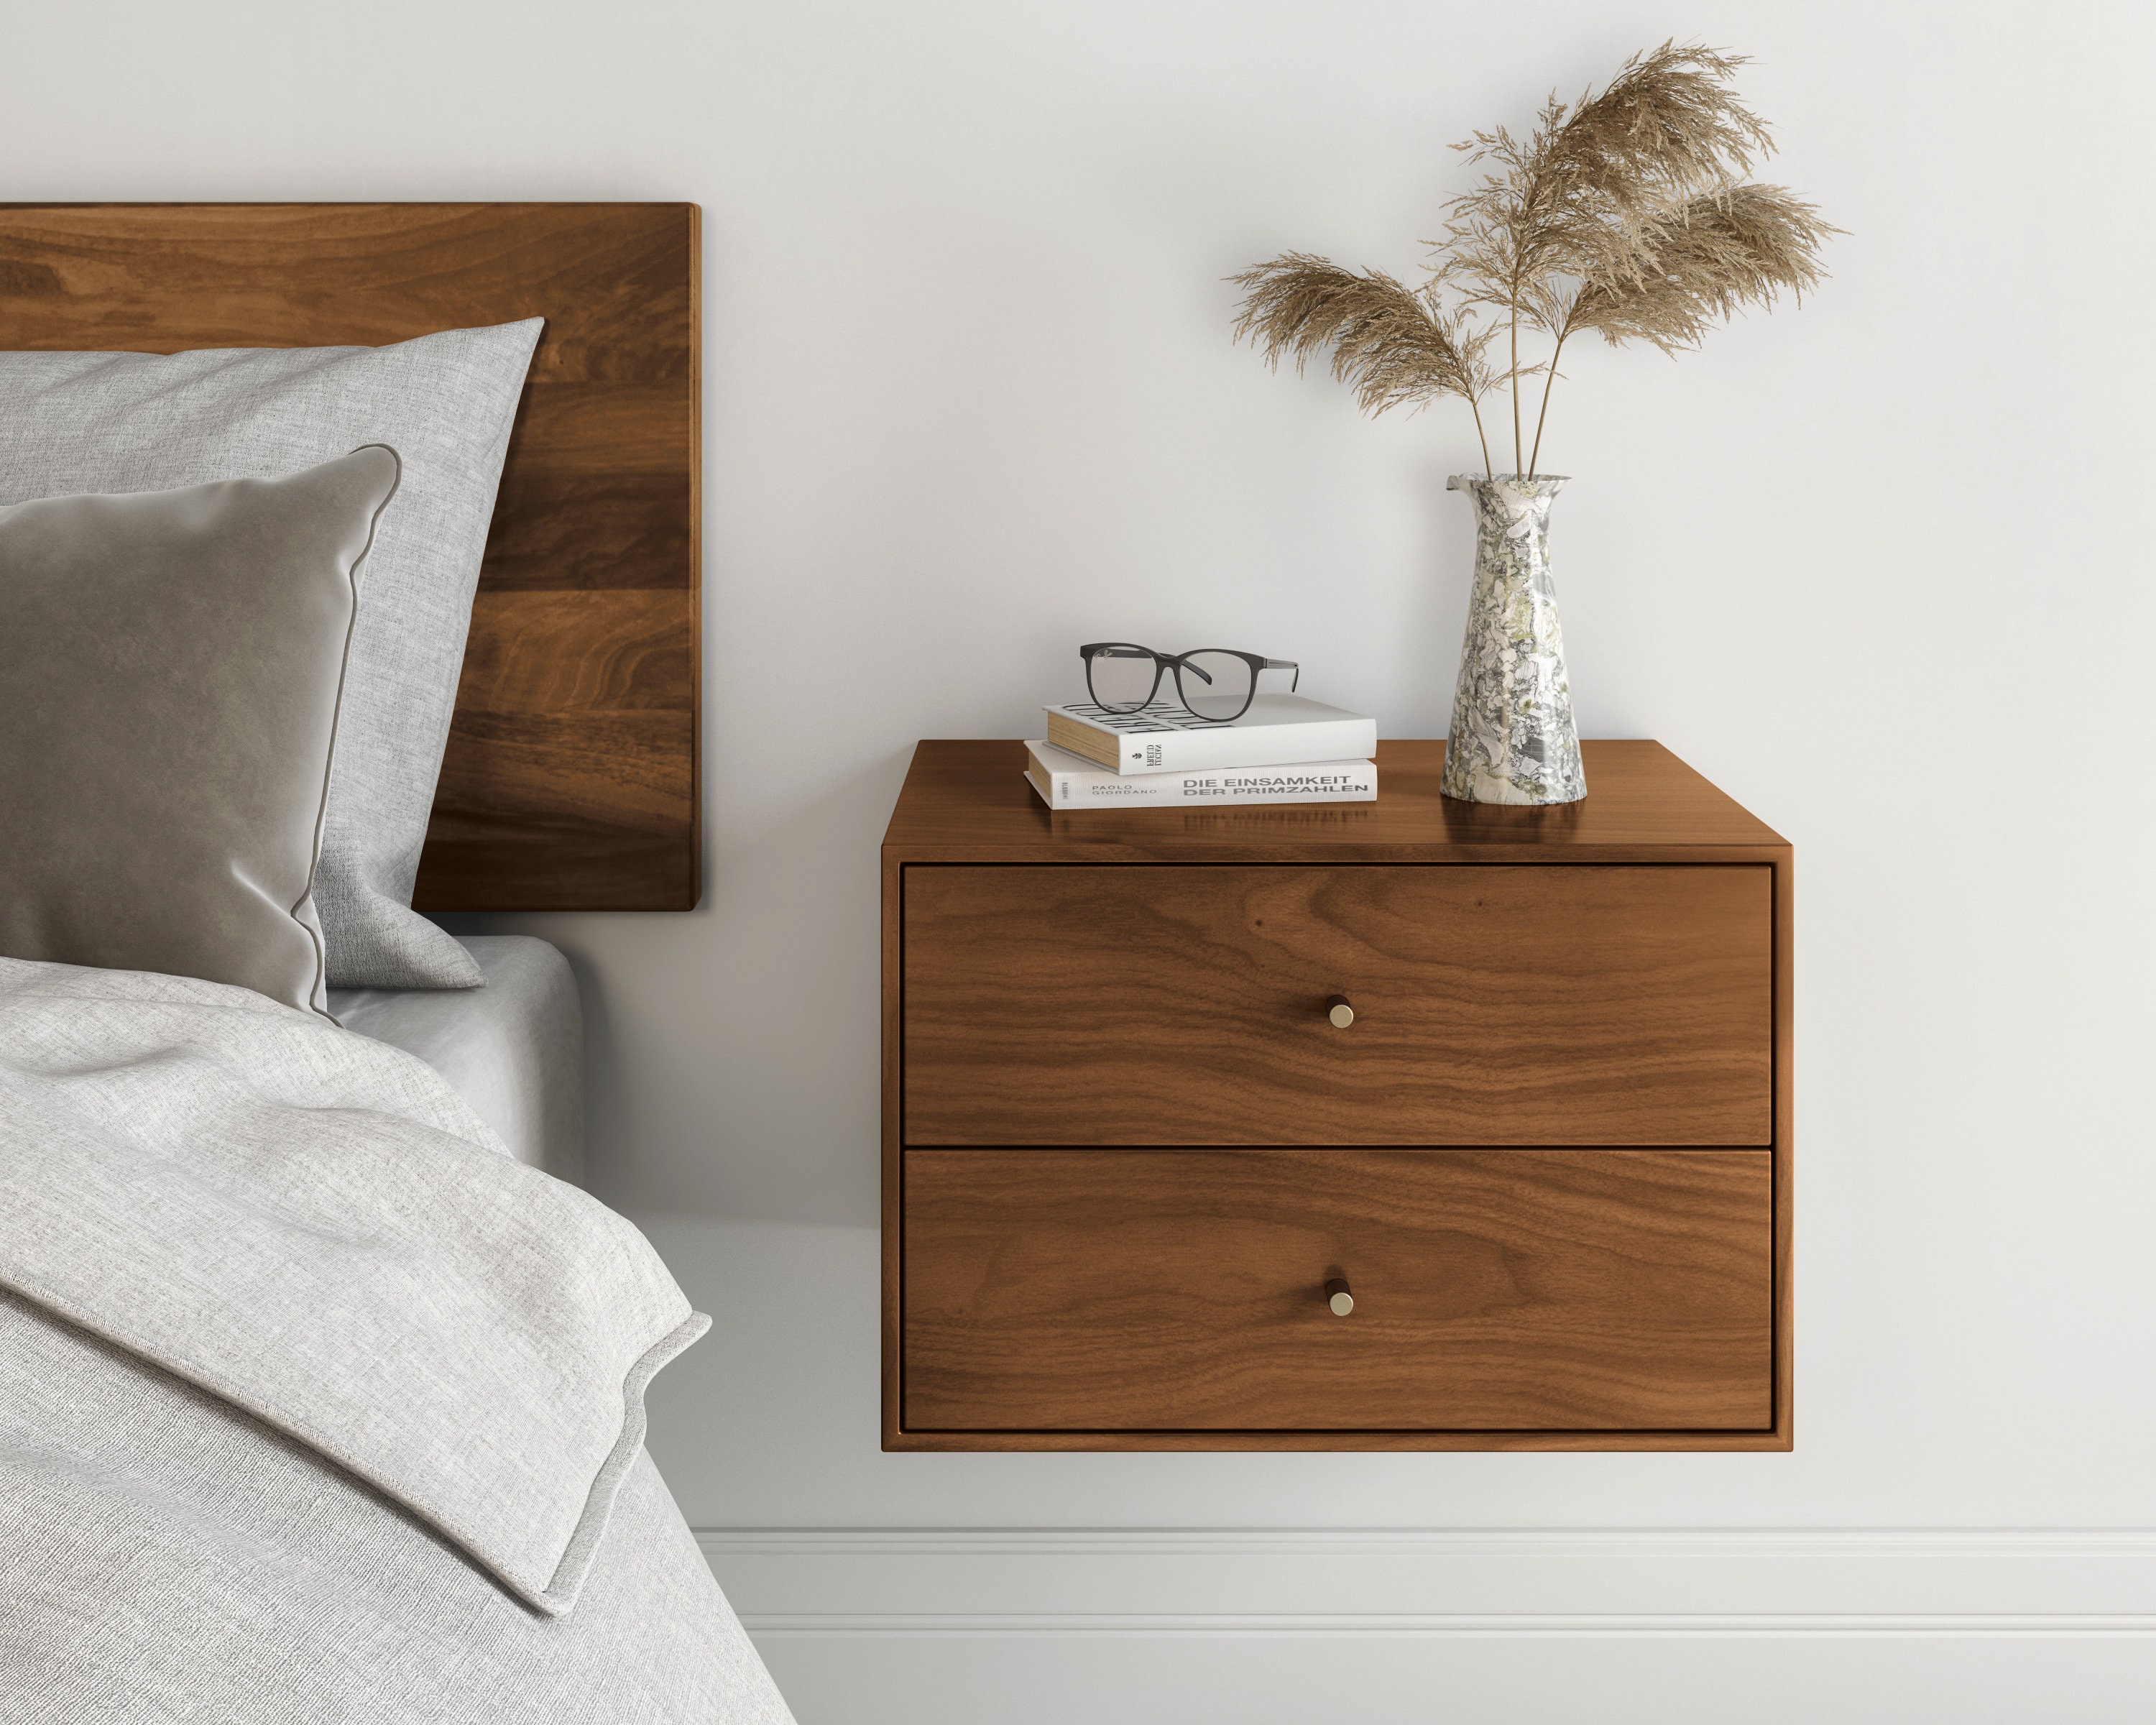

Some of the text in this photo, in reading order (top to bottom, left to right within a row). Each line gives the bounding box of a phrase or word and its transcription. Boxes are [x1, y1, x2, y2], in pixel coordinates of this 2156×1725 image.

[1184, 776, 1351, 788] DIE EINSAMKEIT
[1233, 785, 1368, 795] PRIMZAHLEN
